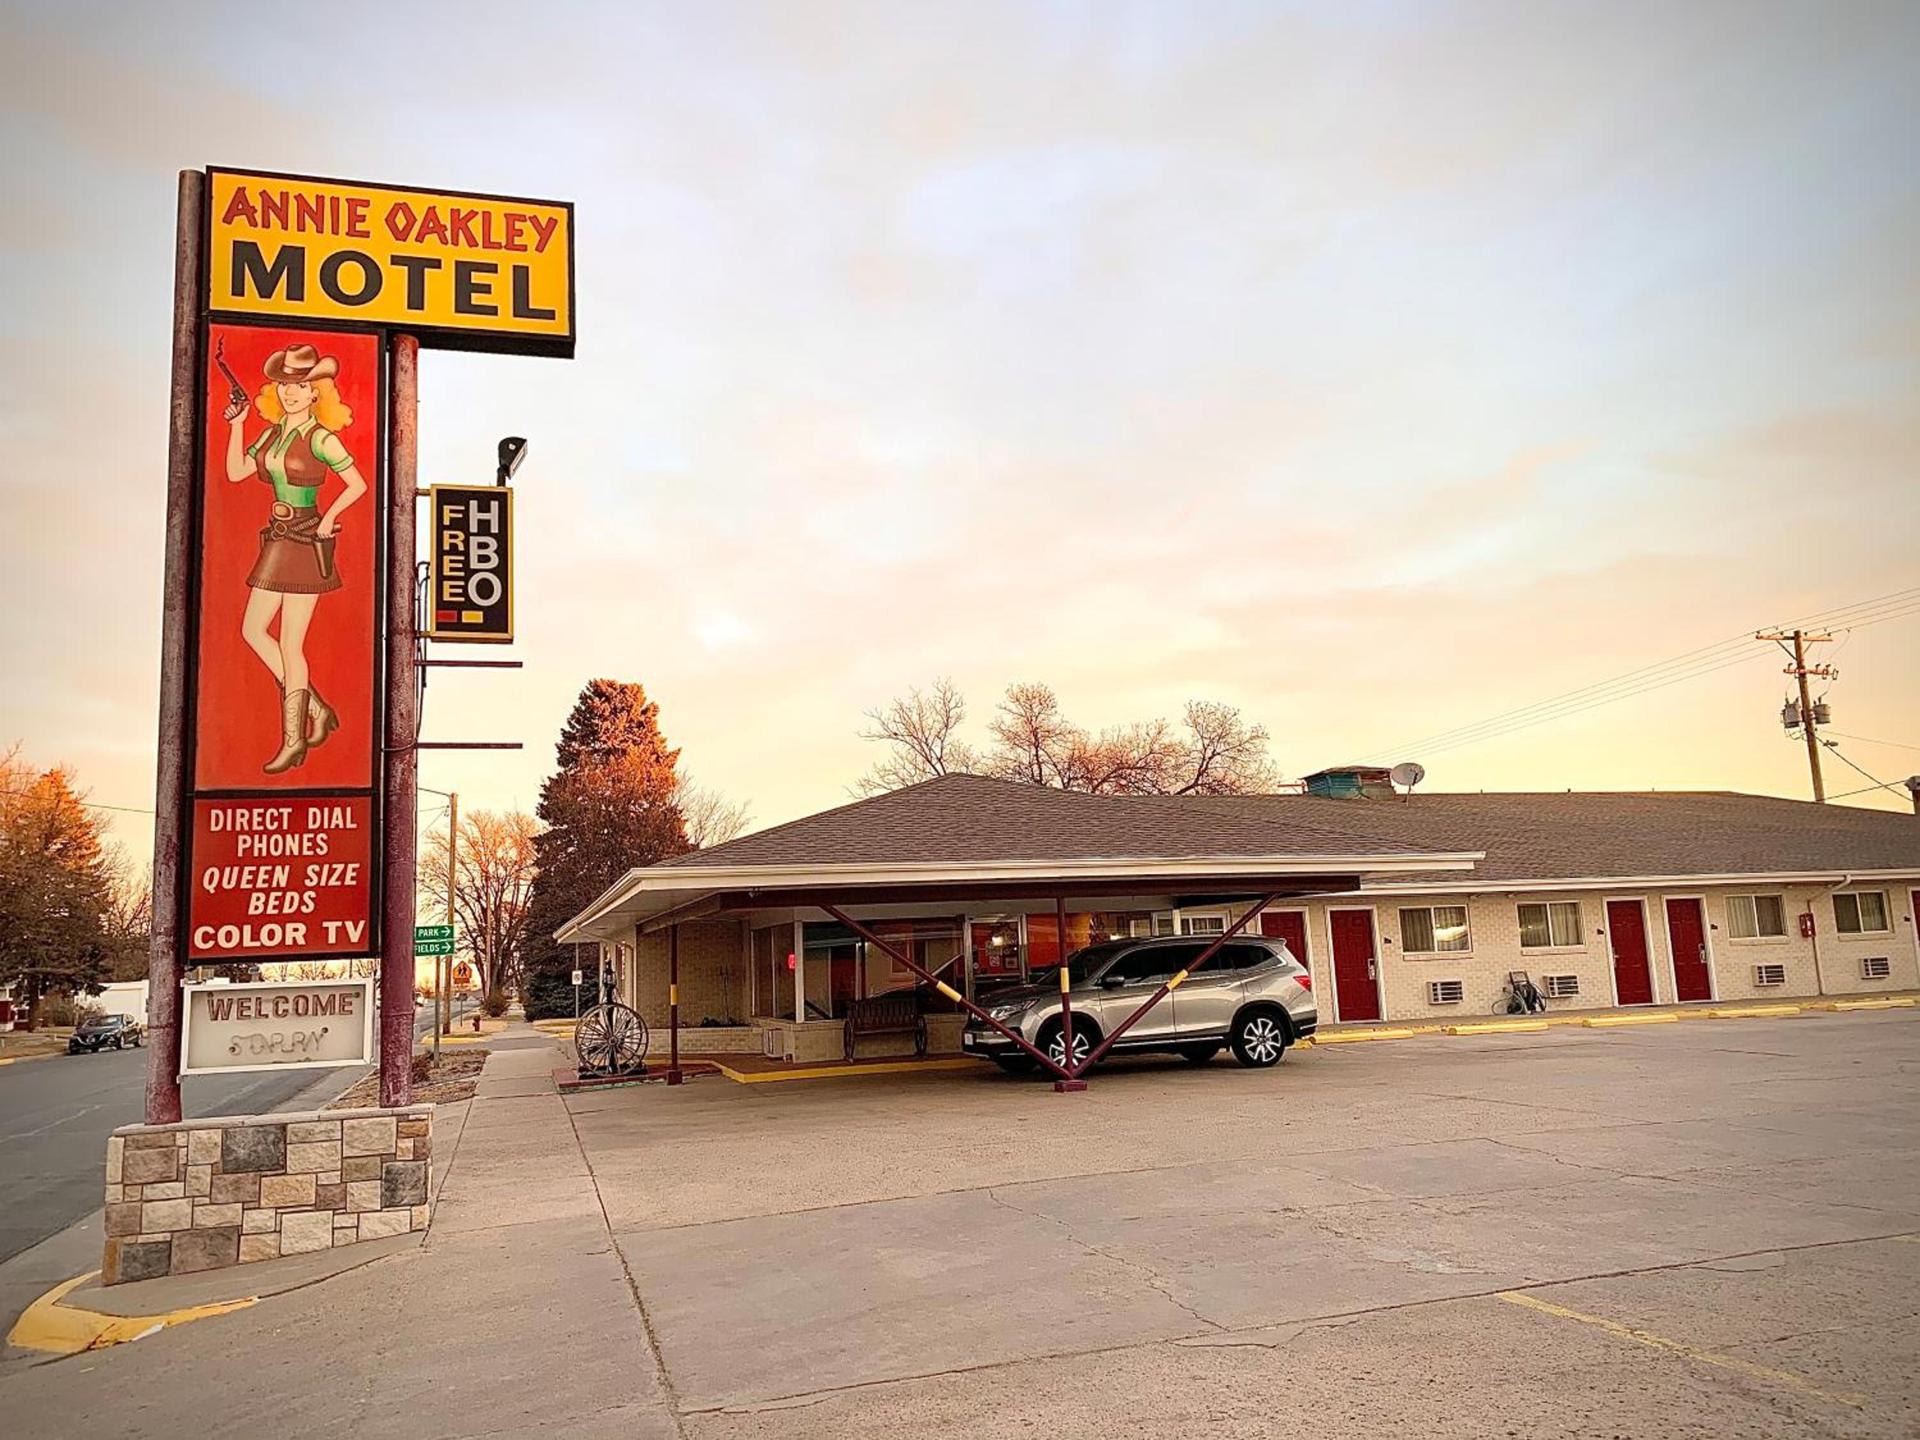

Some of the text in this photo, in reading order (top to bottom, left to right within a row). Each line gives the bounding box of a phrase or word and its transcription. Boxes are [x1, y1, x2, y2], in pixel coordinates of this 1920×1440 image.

[222, 186, 558, 253] ANNIE OAKLEY
[231, 240, 556, 320] MOTEL
[443, 505, 465, 602] FREE
[468, 500, 502, 606] HBO
[210, 807, 357, 831] DIRECT DIAL
[237, 833, 329, 857] PHONES
[202, 863, 360, 893] QUEEN SIZE
[248, 891, 316, 915] BEDS
[194, 920, 365, 949] COLOR TV
[418, 929, 440, 937] PARK
[207, 993, 353, 1021] WELCOME
